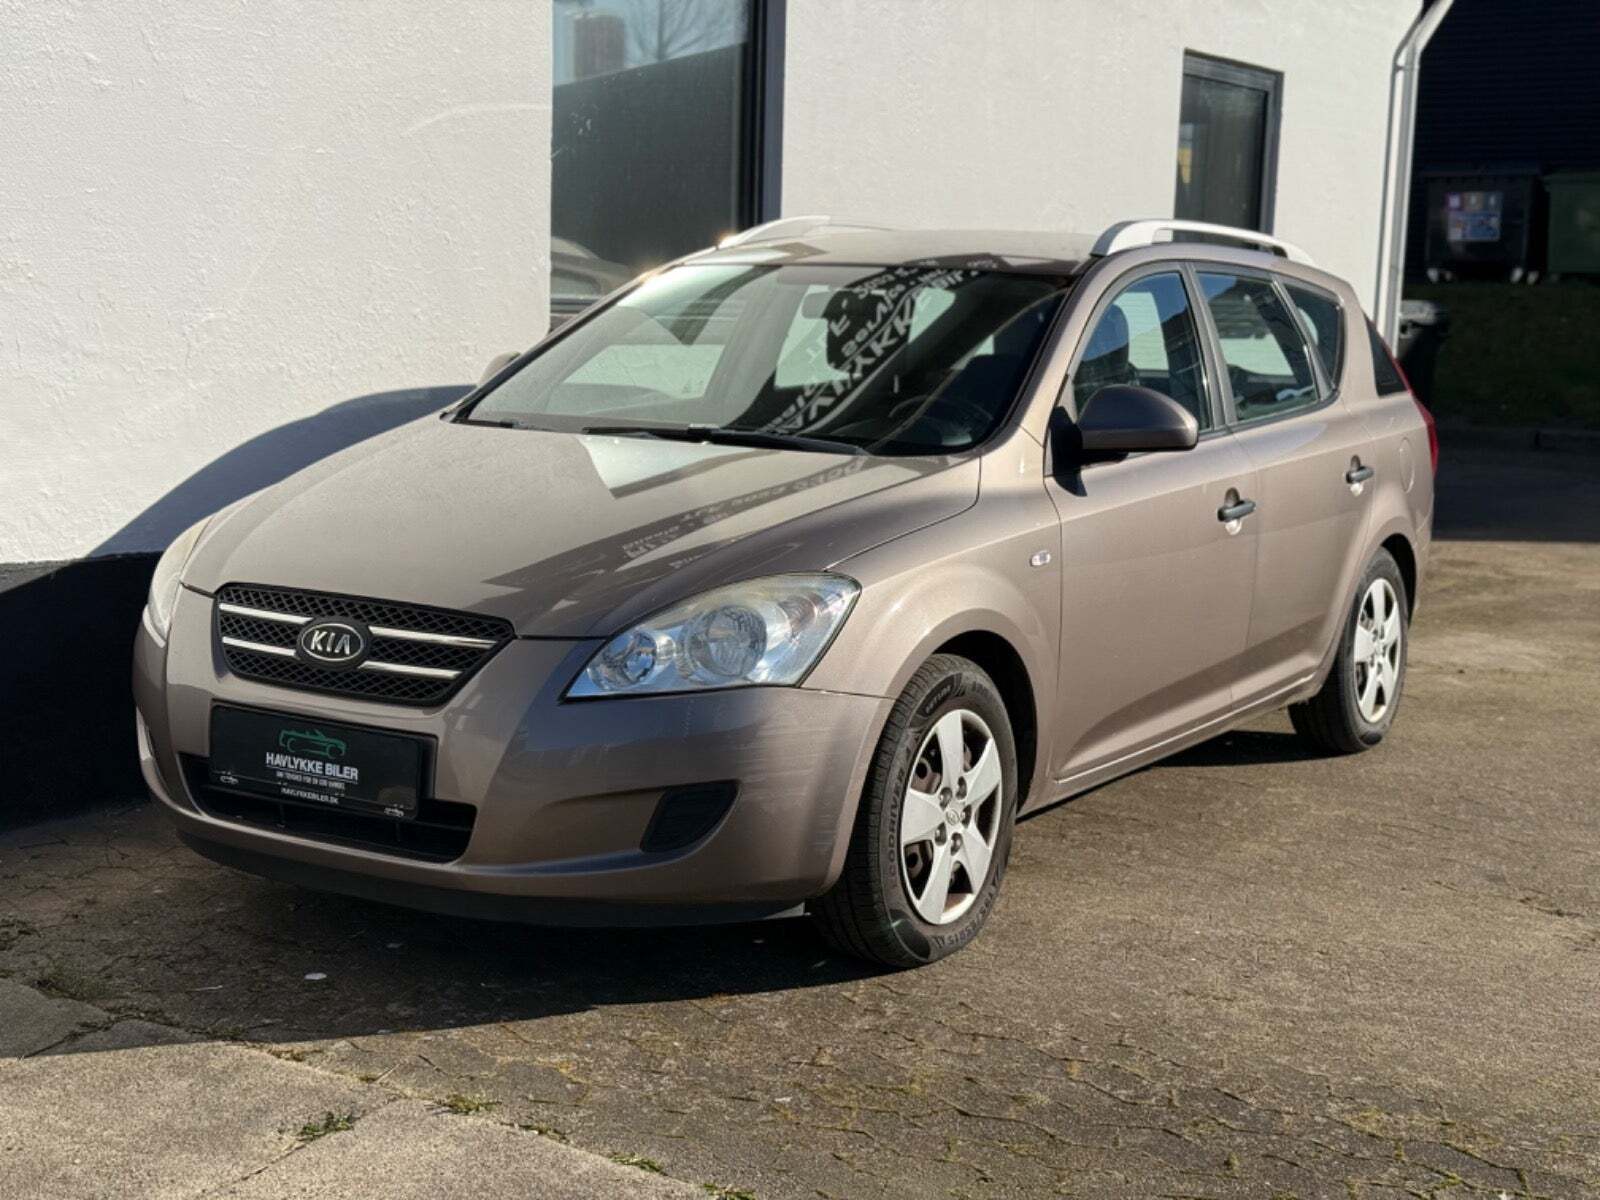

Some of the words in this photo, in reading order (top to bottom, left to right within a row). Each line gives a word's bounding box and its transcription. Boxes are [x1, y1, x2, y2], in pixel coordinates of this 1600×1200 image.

[310, 630, 351, 655] KIA
[265, 752, 323, 774] HAVLYKKE
[324, 763, 359, 781] BILER
